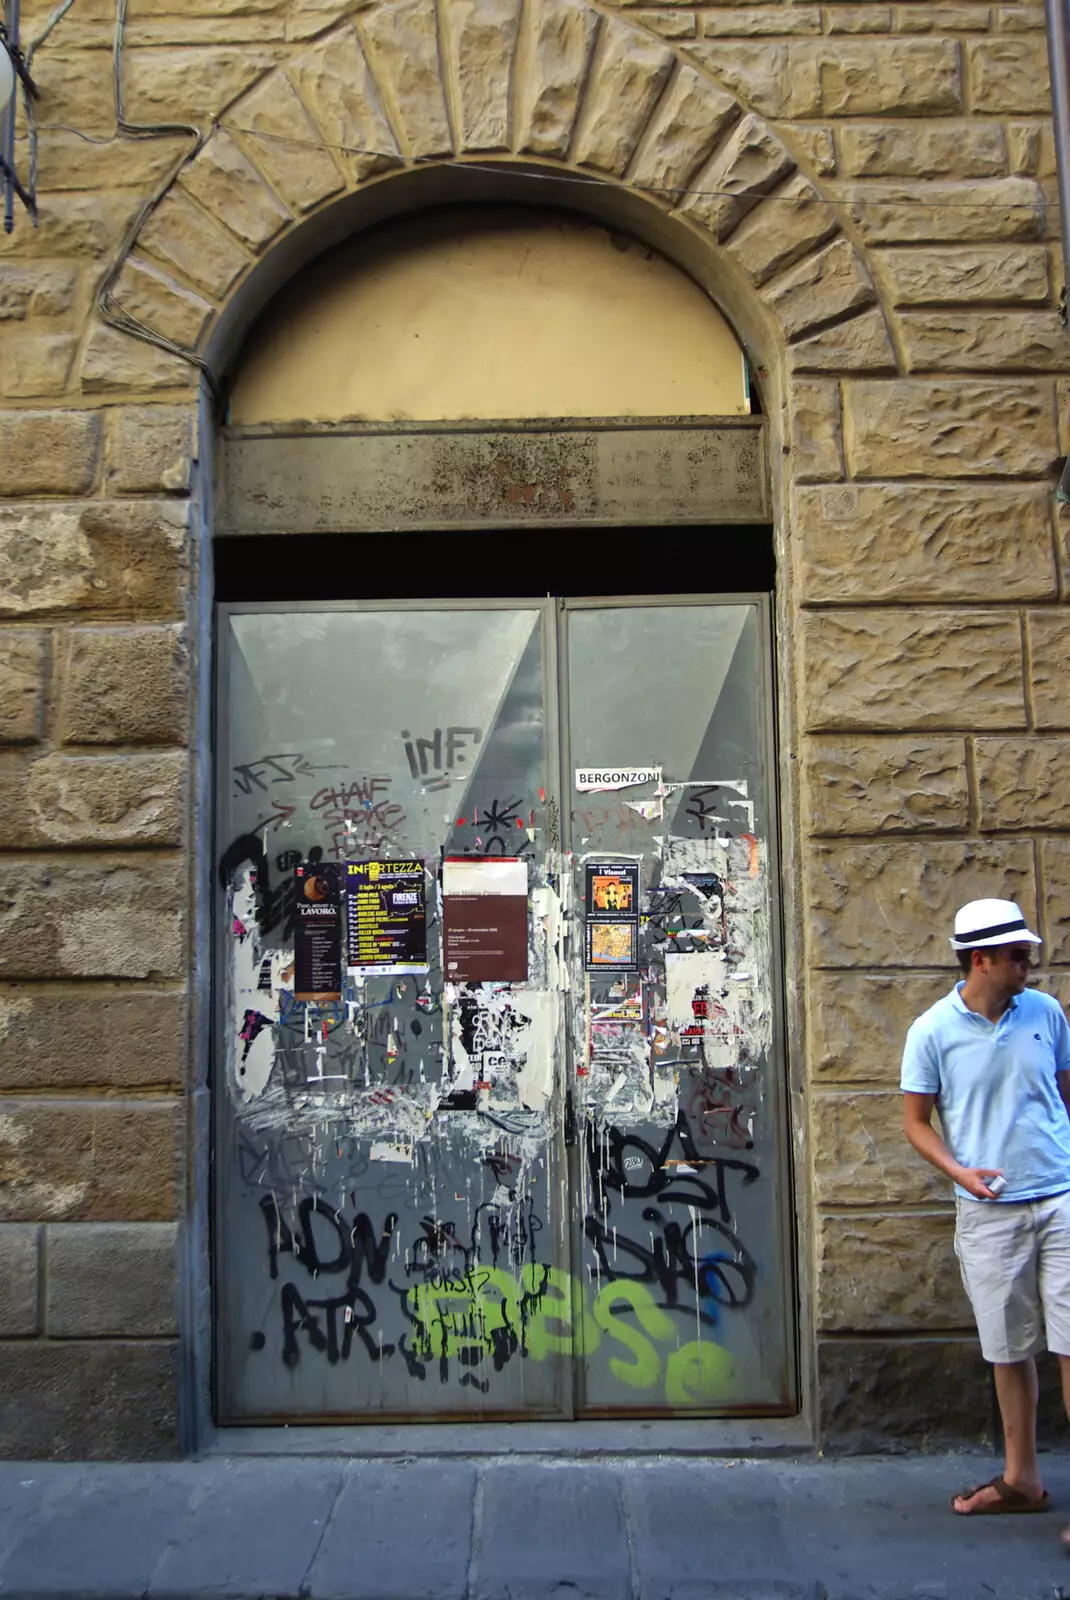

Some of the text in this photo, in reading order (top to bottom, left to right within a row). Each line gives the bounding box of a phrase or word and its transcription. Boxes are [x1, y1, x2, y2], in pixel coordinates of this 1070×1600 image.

[579, 772, 660, 784] BERGONZONI
[393, 892, 418, 901] FIRENZE
[301, 908, 337, 916] LAVORO.
